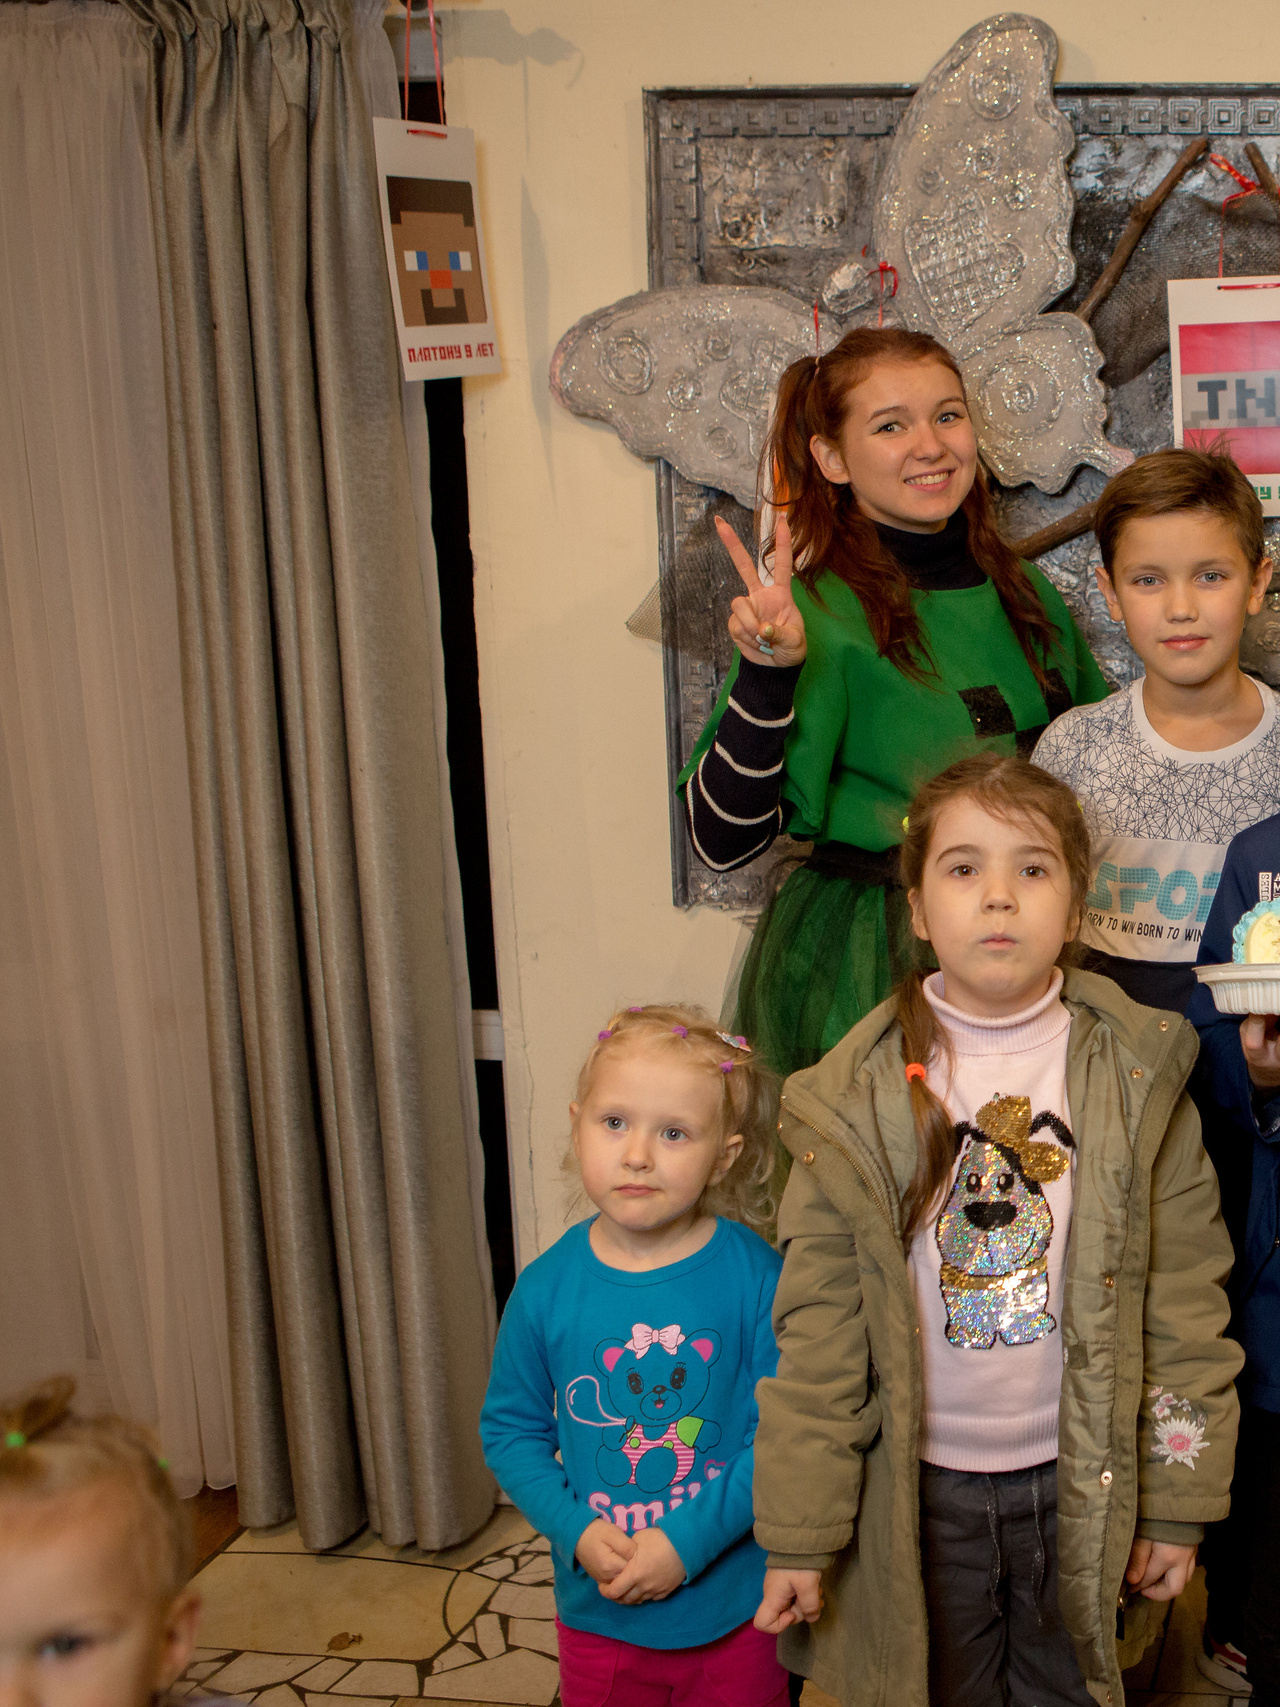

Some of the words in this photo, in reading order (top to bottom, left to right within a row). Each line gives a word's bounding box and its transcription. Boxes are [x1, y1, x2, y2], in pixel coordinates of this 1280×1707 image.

[407, 344, 462, 363] ПЛАТОНУ
[464, 344, 473, 359] 9
[476, 342, 494, 358] ЛЕТ
[1261, 873, 1270, 902] ULES
[1087, 912, 1105, 927] ORN
[1107, 917, 1118, 931] TO
[1136, 922, 1164, 939] BORN
[1166, 926, 1180, 940] TO
